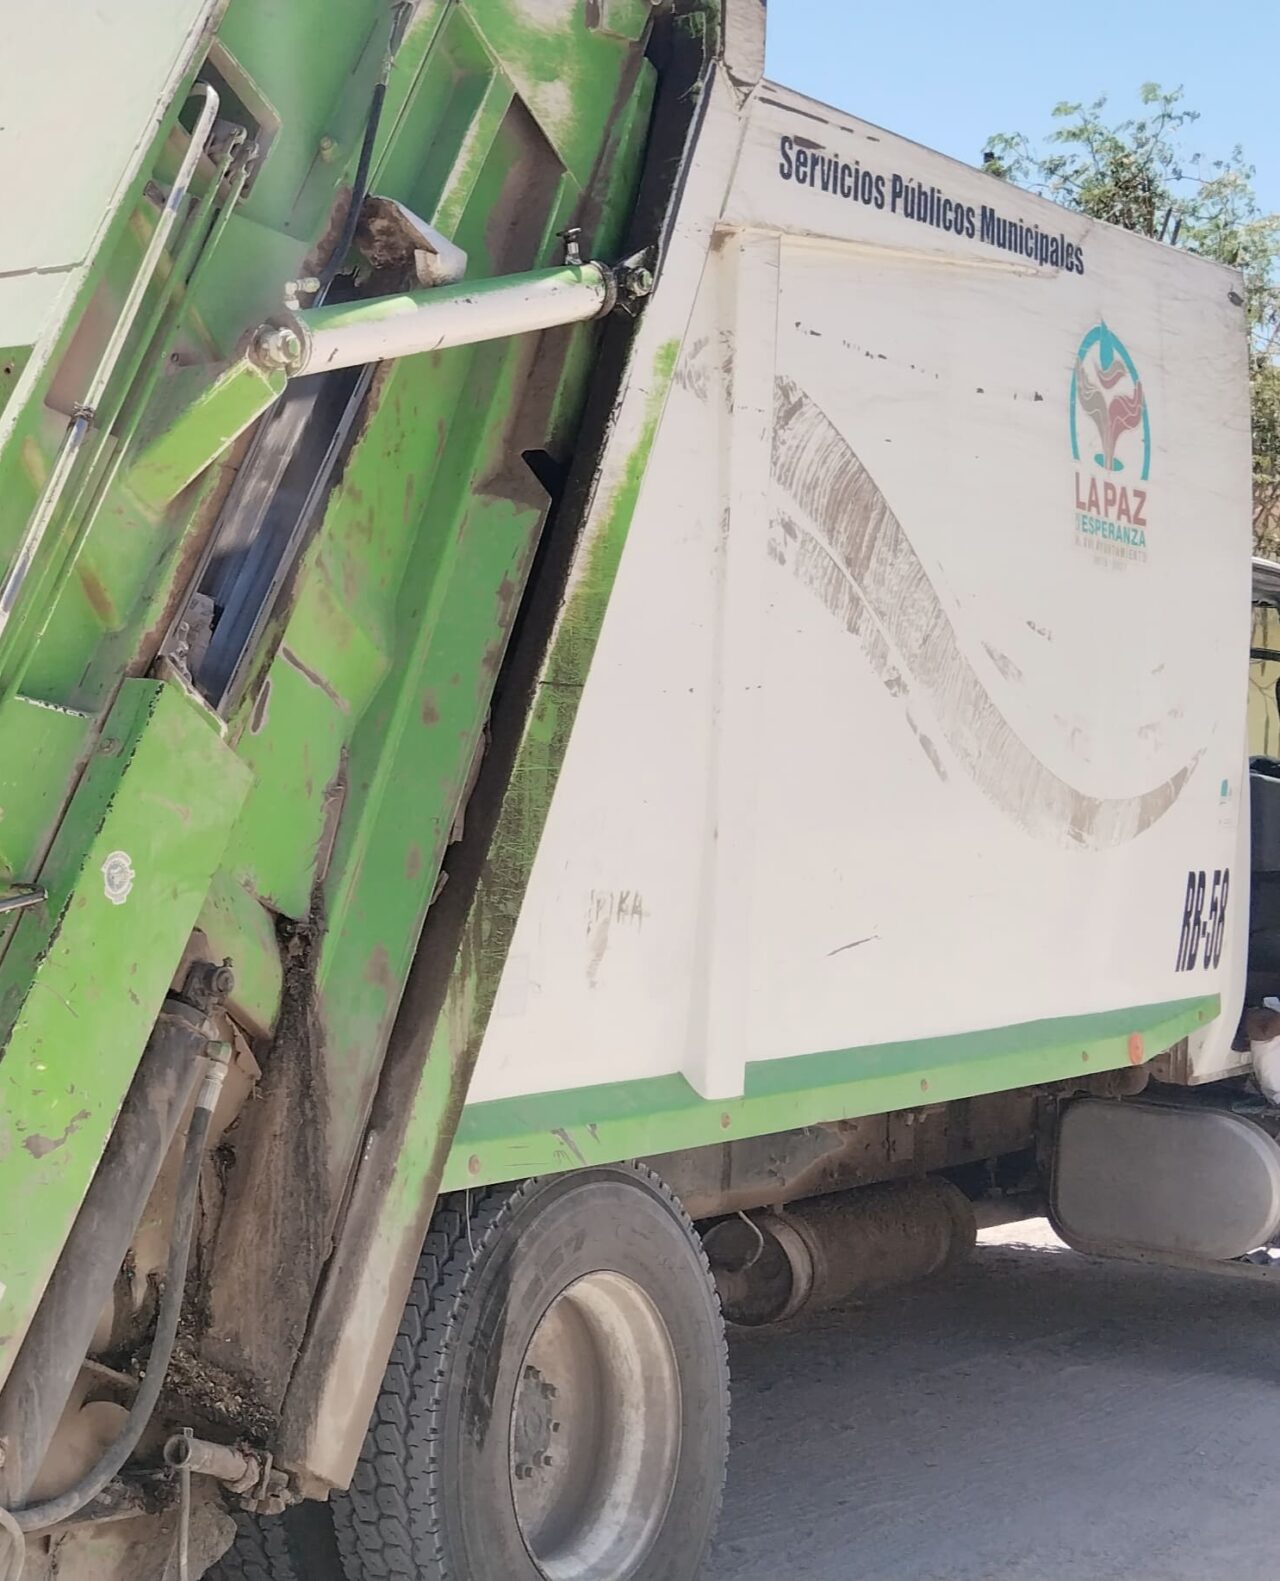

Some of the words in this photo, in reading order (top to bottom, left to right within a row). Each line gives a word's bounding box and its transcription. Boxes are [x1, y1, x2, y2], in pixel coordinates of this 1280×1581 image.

[779, 135, 886, 210] Servicios
[890, 173, 977, 239] Públicos
[979, 204, 1085, 275] Municipales
[1081, 513, 1147, 548] ESPERANZA
[1174, 867, 1230, 972] RB-58
